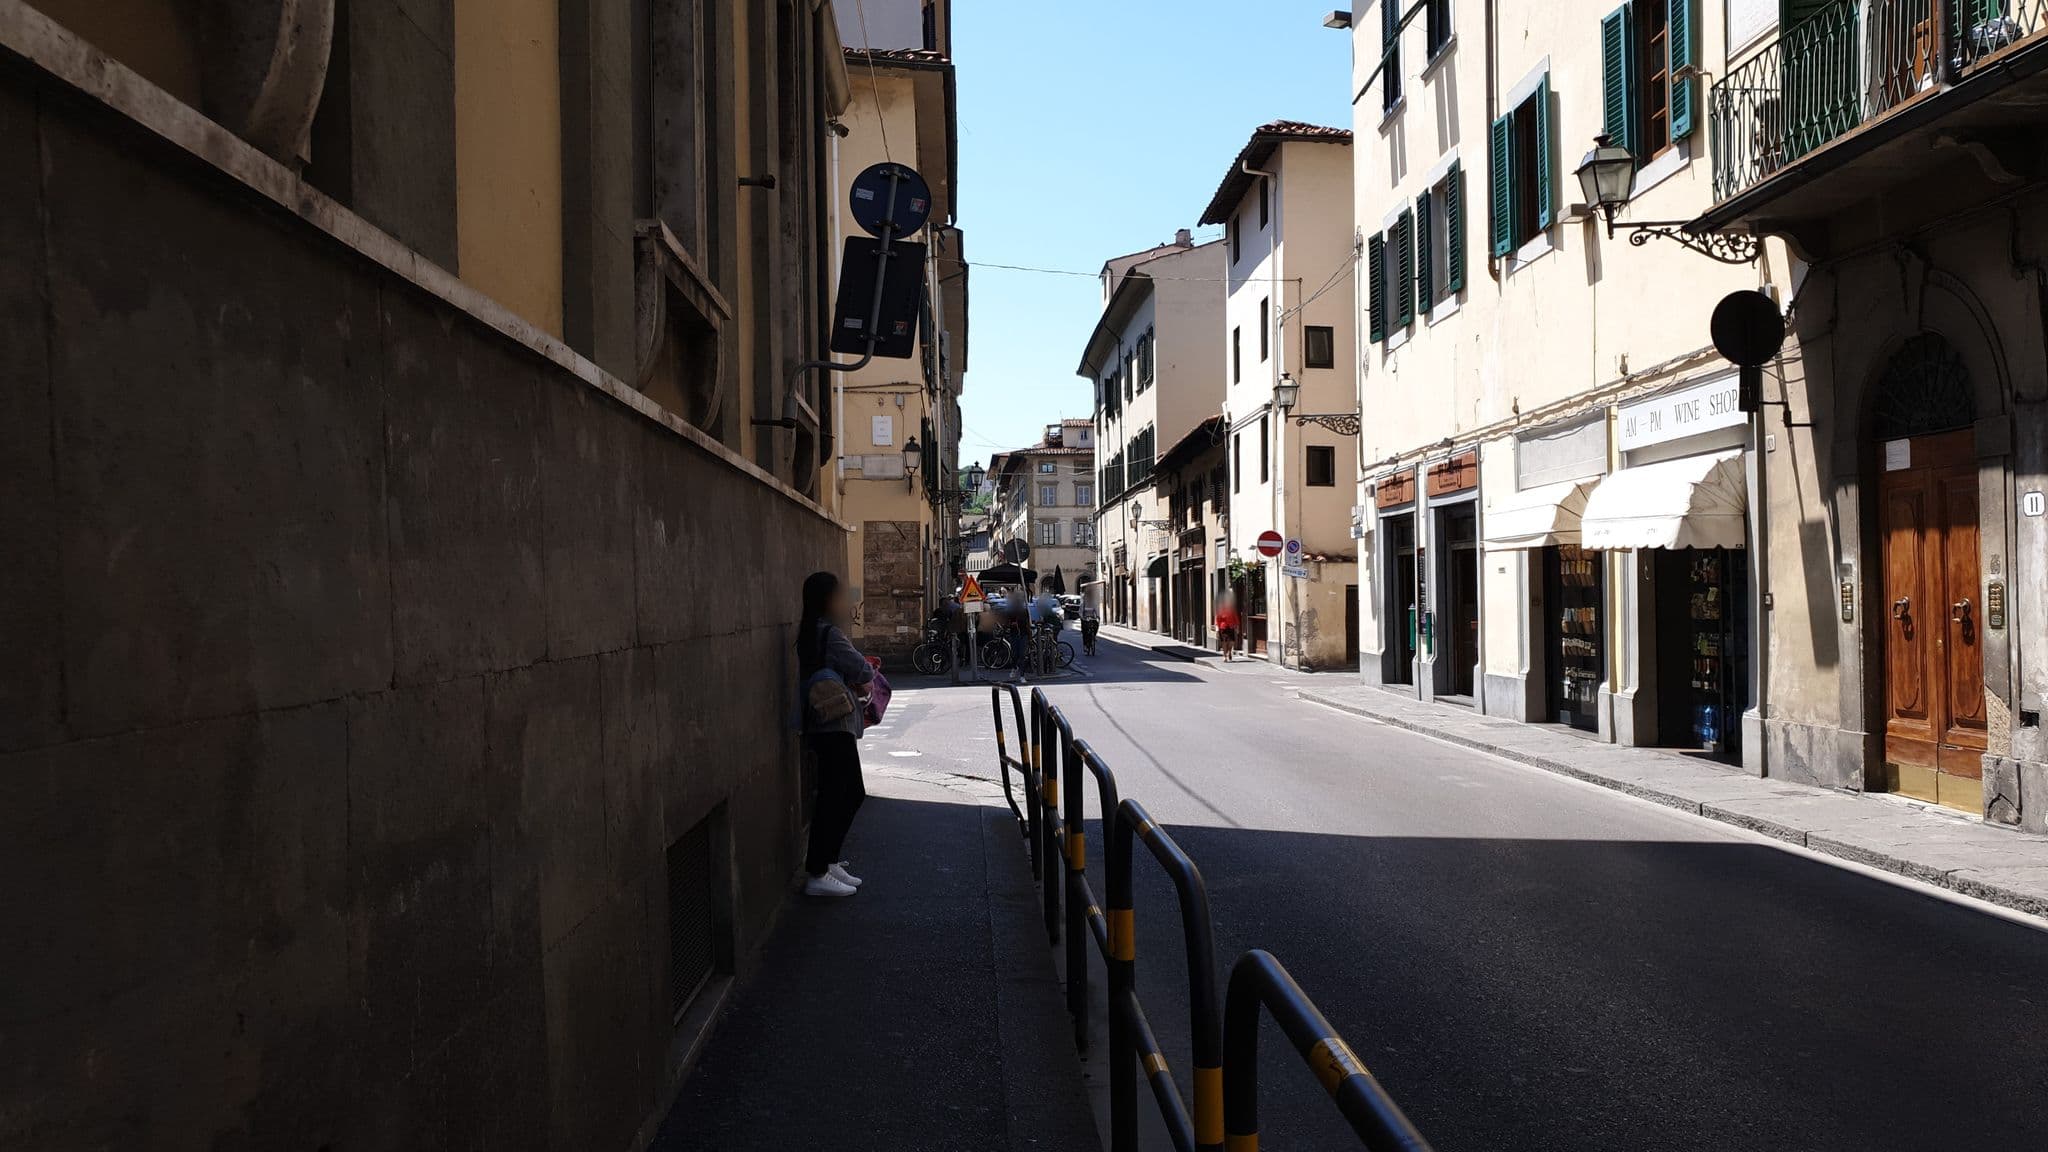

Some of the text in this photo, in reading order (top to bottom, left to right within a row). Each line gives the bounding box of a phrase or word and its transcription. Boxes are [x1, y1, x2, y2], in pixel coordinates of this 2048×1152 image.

[1625, 415, 1637, 438] AM
[1650, 409, 1662, 433] PM
[1674, 399, 1700, 425] WINE
[1709, 389, 1738, 416] SHOP
[2030, 496, 2039, 512] 11
